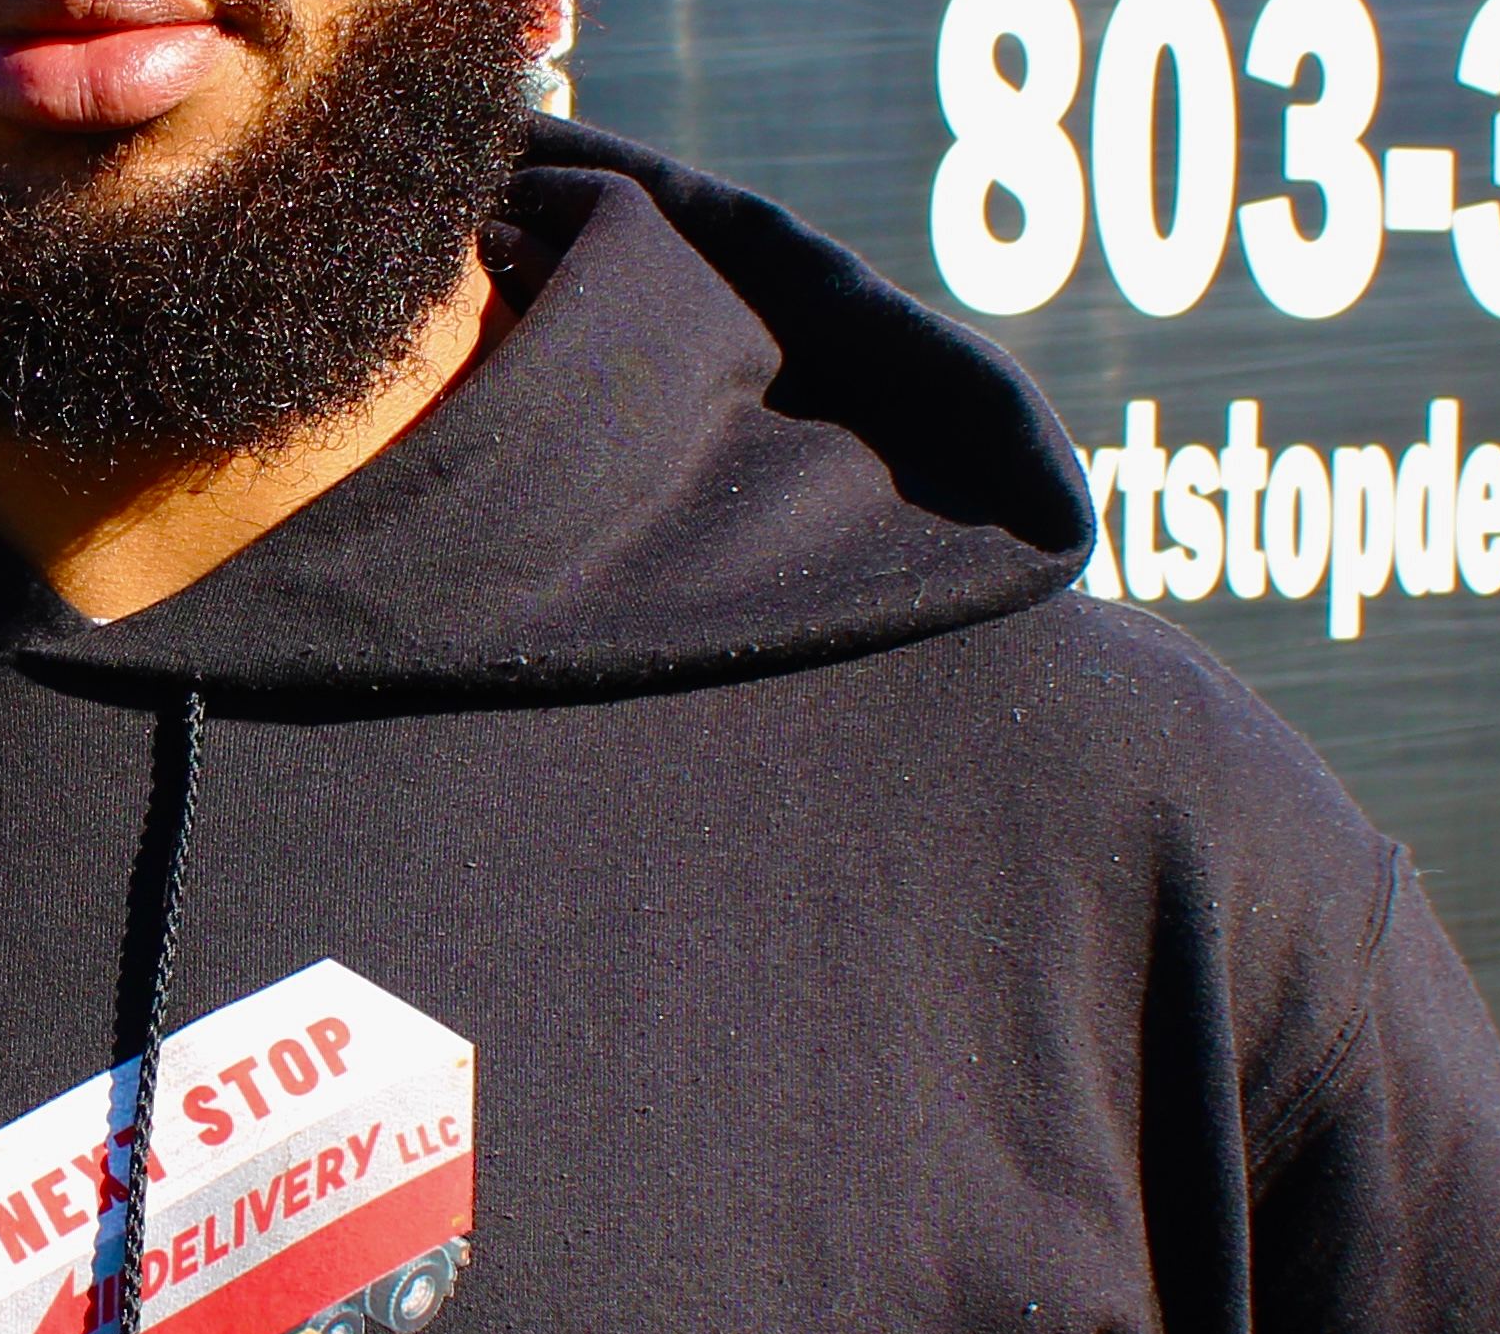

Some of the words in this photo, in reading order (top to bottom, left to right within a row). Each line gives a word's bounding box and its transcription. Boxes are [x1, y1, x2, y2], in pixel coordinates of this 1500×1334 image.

[181, 1016, 354, 1147] STOP
[140, 1122, 383, 1302] DELIVERY
[396, 1115, 463, 1166] LLC
